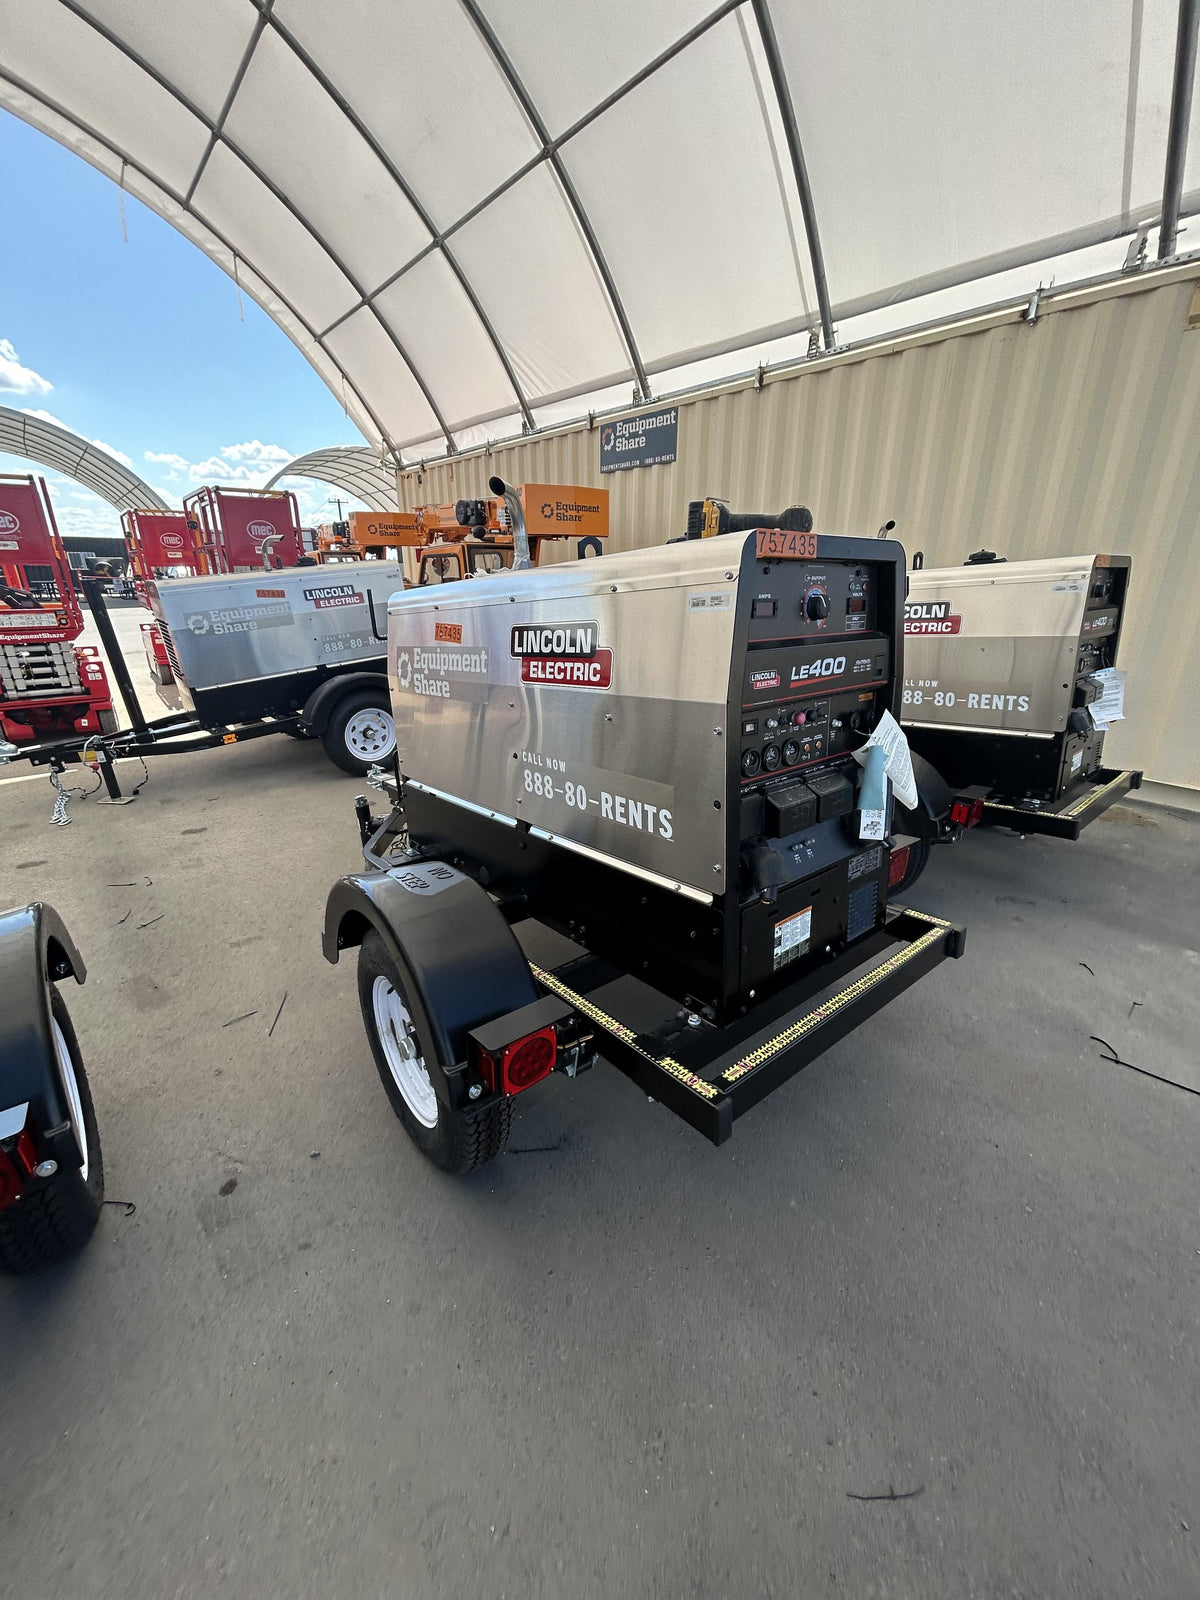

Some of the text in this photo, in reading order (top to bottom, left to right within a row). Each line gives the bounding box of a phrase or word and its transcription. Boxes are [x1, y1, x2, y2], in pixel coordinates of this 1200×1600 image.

[616, 410, 676, 437] Equipment
[615, 436, 646, 452] Share
[555, 502, 600, 513] Equipment
[555, 512, 582, 522] Share
[250, 524, 273, 535] mec
[378, 523, 415, 531] Equipment
[163, 536, 180, 545] mec
[758, 531, 815, 555] 757435
[305, 586, 353, 600] LINCOLN
[320, 596, 360, 607] ELECTRIC
[208, 603, 290, 622] Equipment
[212, 621, 258, 635] Share
[435, 625, 461, 641] 757435
[514, 628, 592, 653] LINCOLN
[413, 647, 488, 675] Equipment
[790, 656, 847, 681] LE400
[529, 661, 601, 682] ELECTRIC
[751, 671, 776, 681] LINCOLN
[413, 673, 450, 698] Share
[756, 679, 778, 687] ELECTRIC
[522, 751, 567, 773] CALL NOW
[523, 769, 674, 839] 888-80-RENTS
[395, 872, 430, 889] STEP
[427, 867, 455, 880] NO
[578, 1000, 605, 1021] DEBOUT
[604, 1019, 616, 1028] ICI
[749, 1054, 762, 1064] DO
[763, 1043, 778, 1056] NOT
[777, 1028, 800, 1045] STAND
[799, 1015, 819, 1030] HERE
[832, 997, 845, 1007] PAS
[665, 1062, 688, 1077] AQUI
